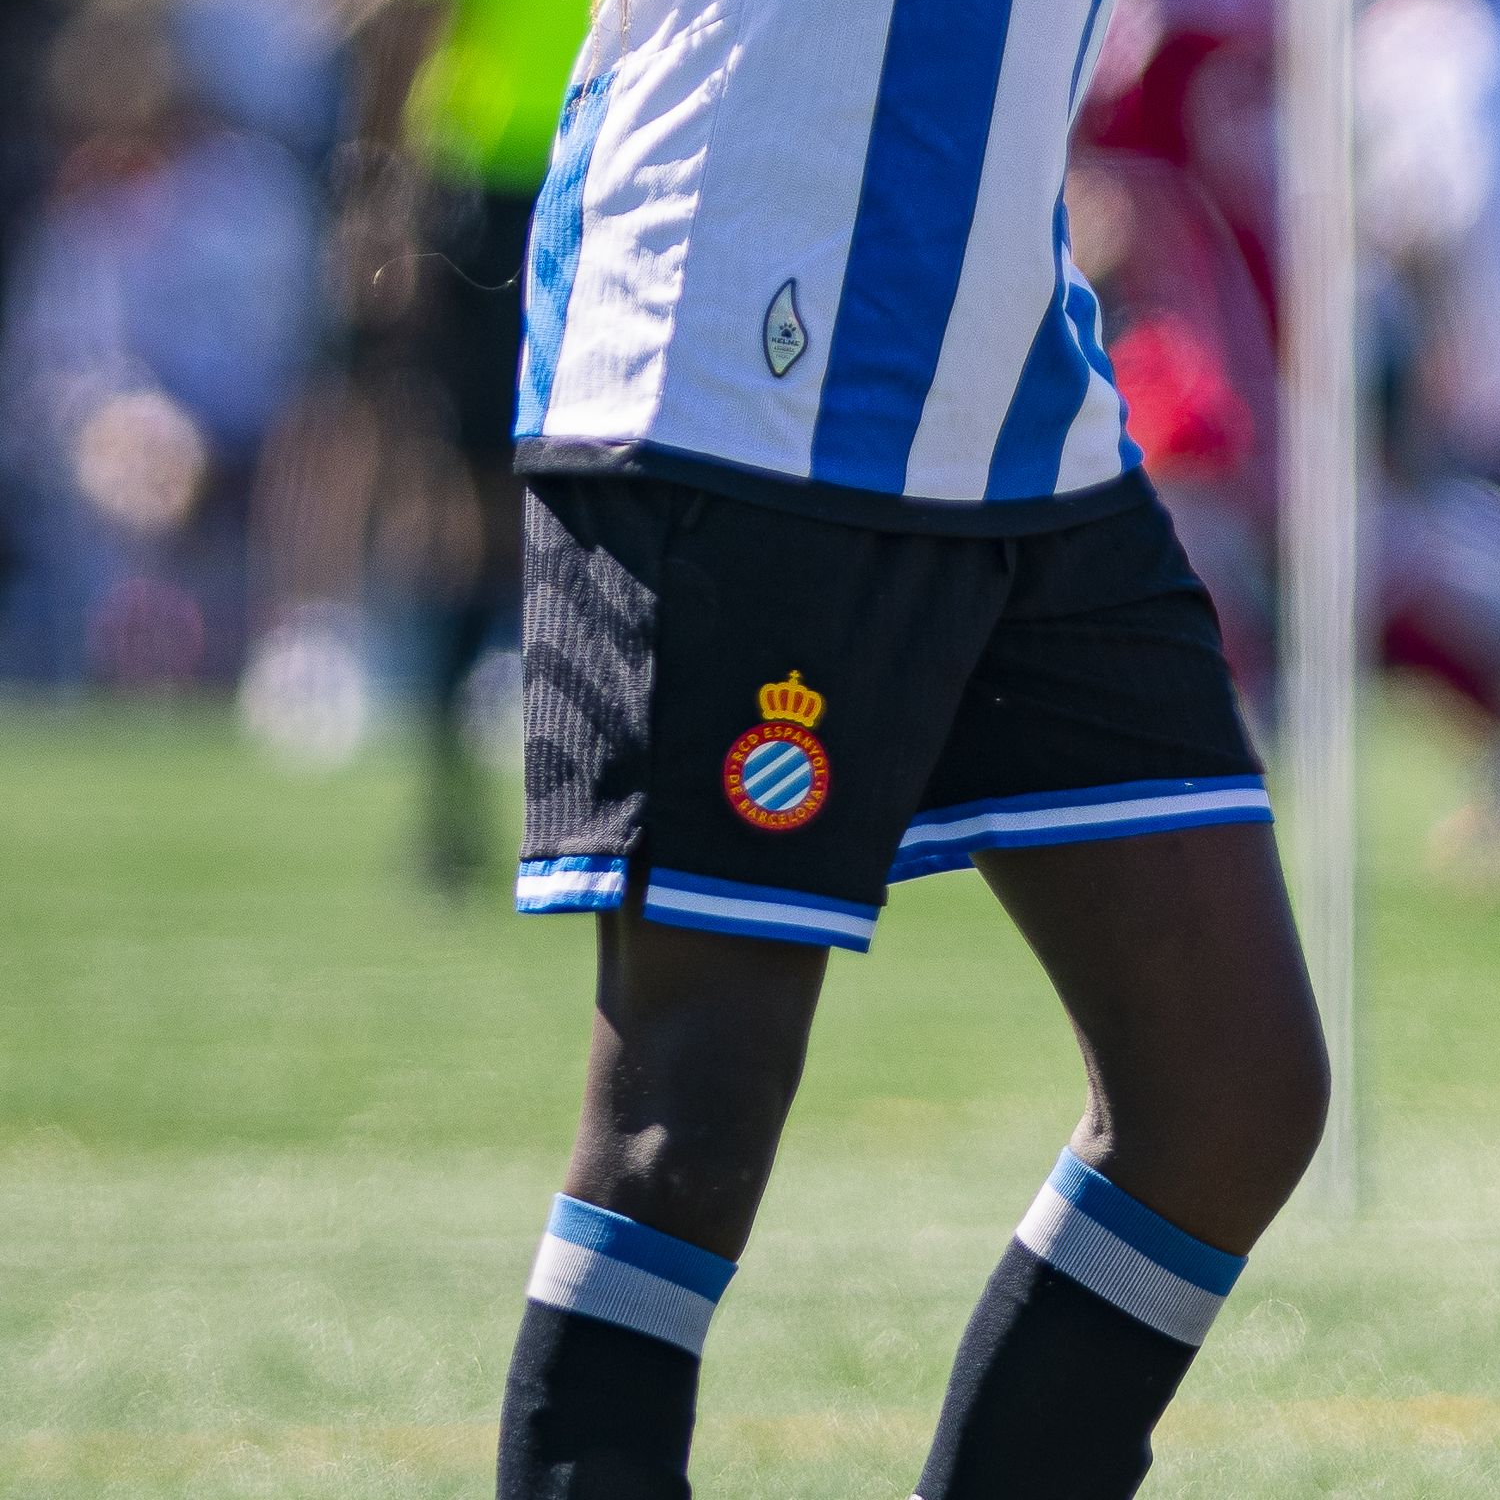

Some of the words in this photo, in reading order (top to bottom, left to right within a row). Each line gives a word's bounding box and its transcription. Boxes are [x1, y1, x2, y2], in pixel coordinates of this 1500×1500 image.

[731, 733, 760, 762] RCD
[763, 725, 826, 776] ESPANYOL
[729, 773, 743, 796] DE
[737, 789, 824, 826] BARCELONA
